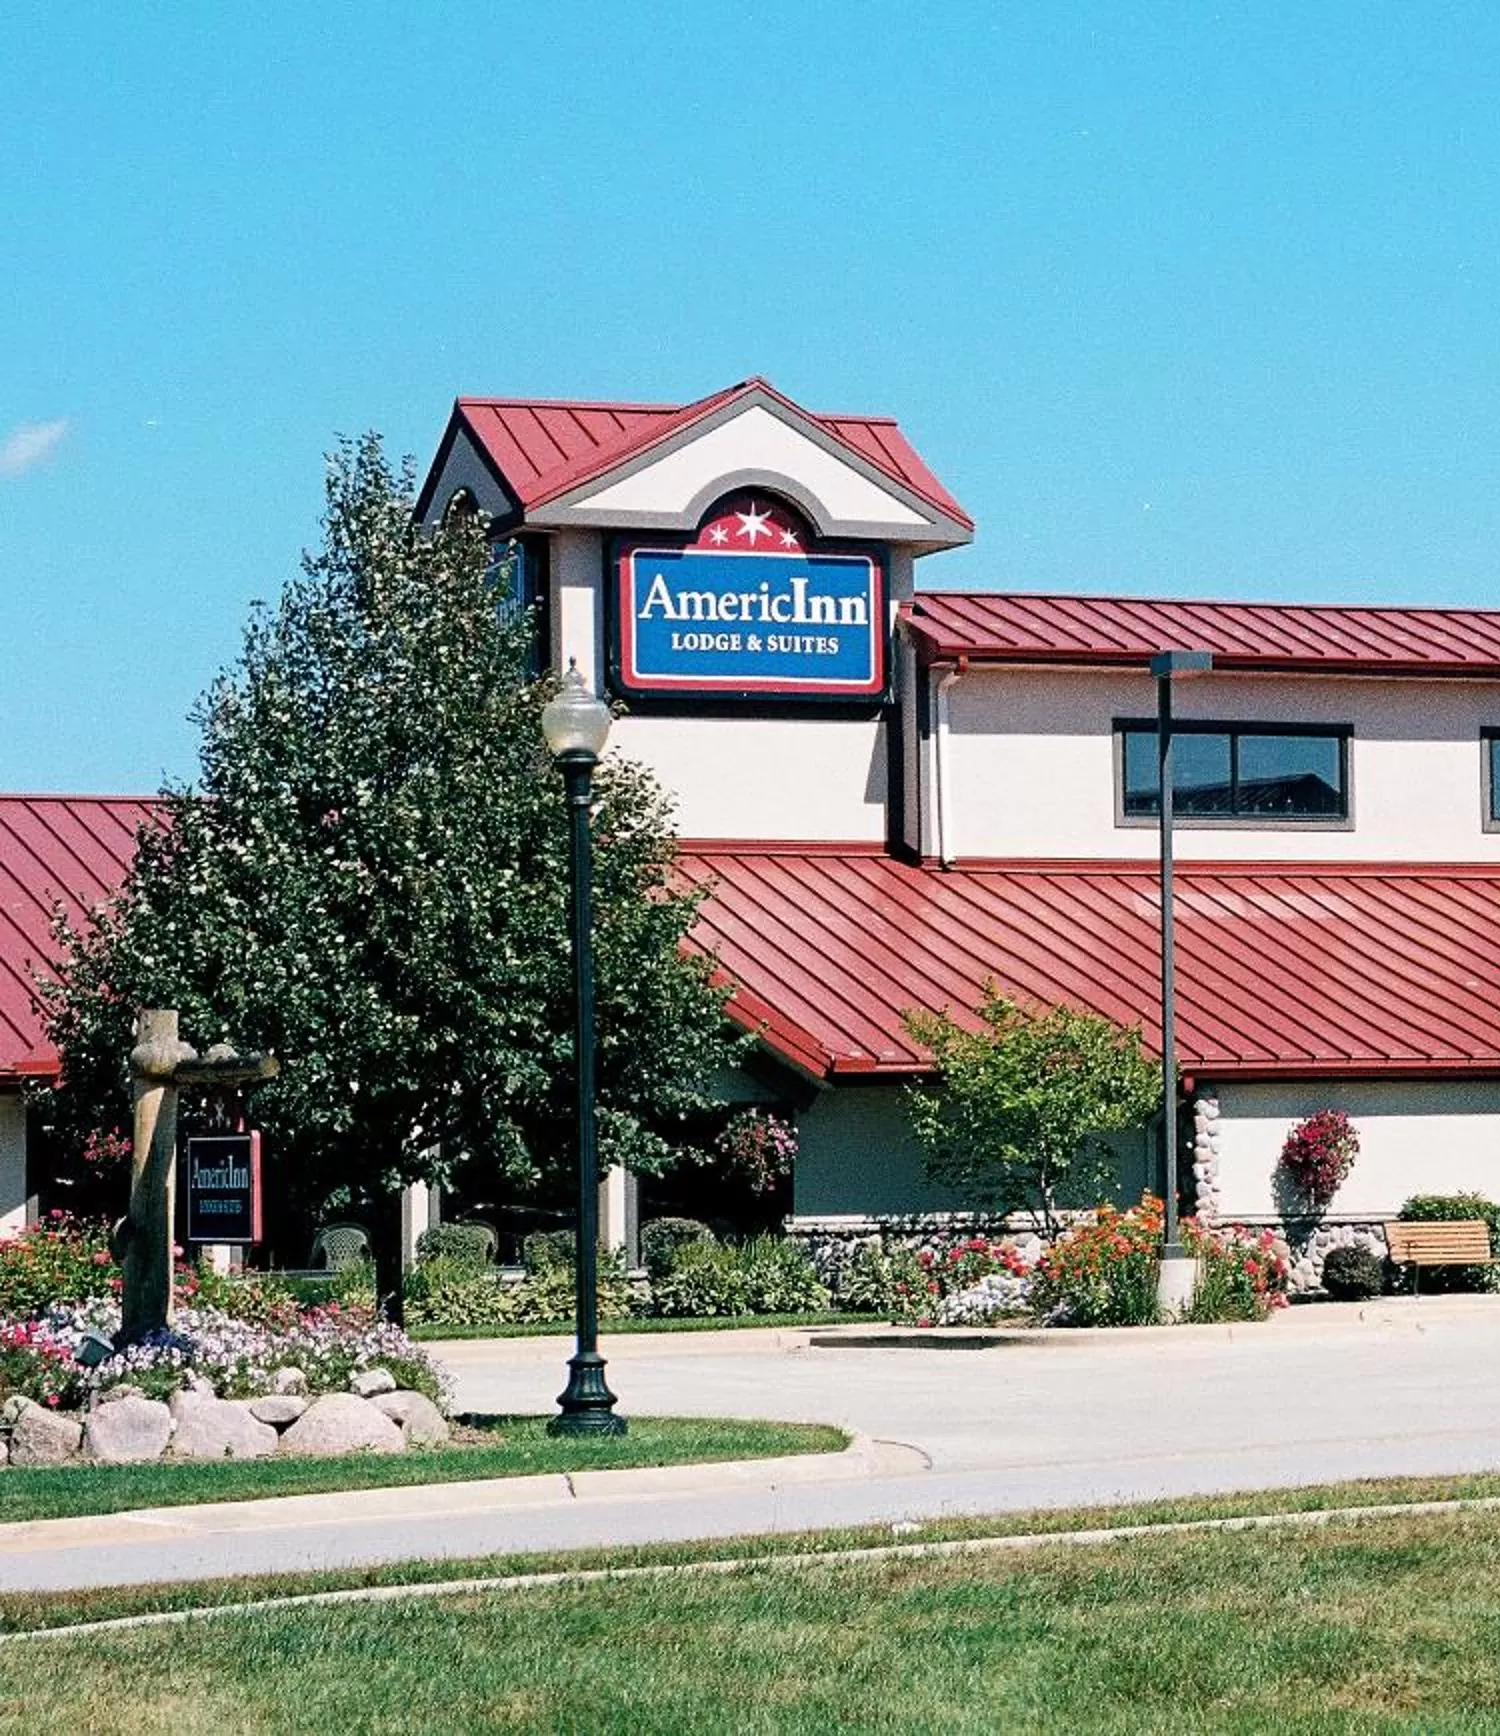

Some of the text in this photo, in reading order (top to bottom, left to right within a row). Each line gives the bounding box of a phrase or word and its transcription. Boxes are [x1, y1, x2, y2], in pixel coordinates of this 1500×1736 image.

[637, 573, 869, 625] AmericInn
[671, 632, 840, 655] LODGE & SUITES
